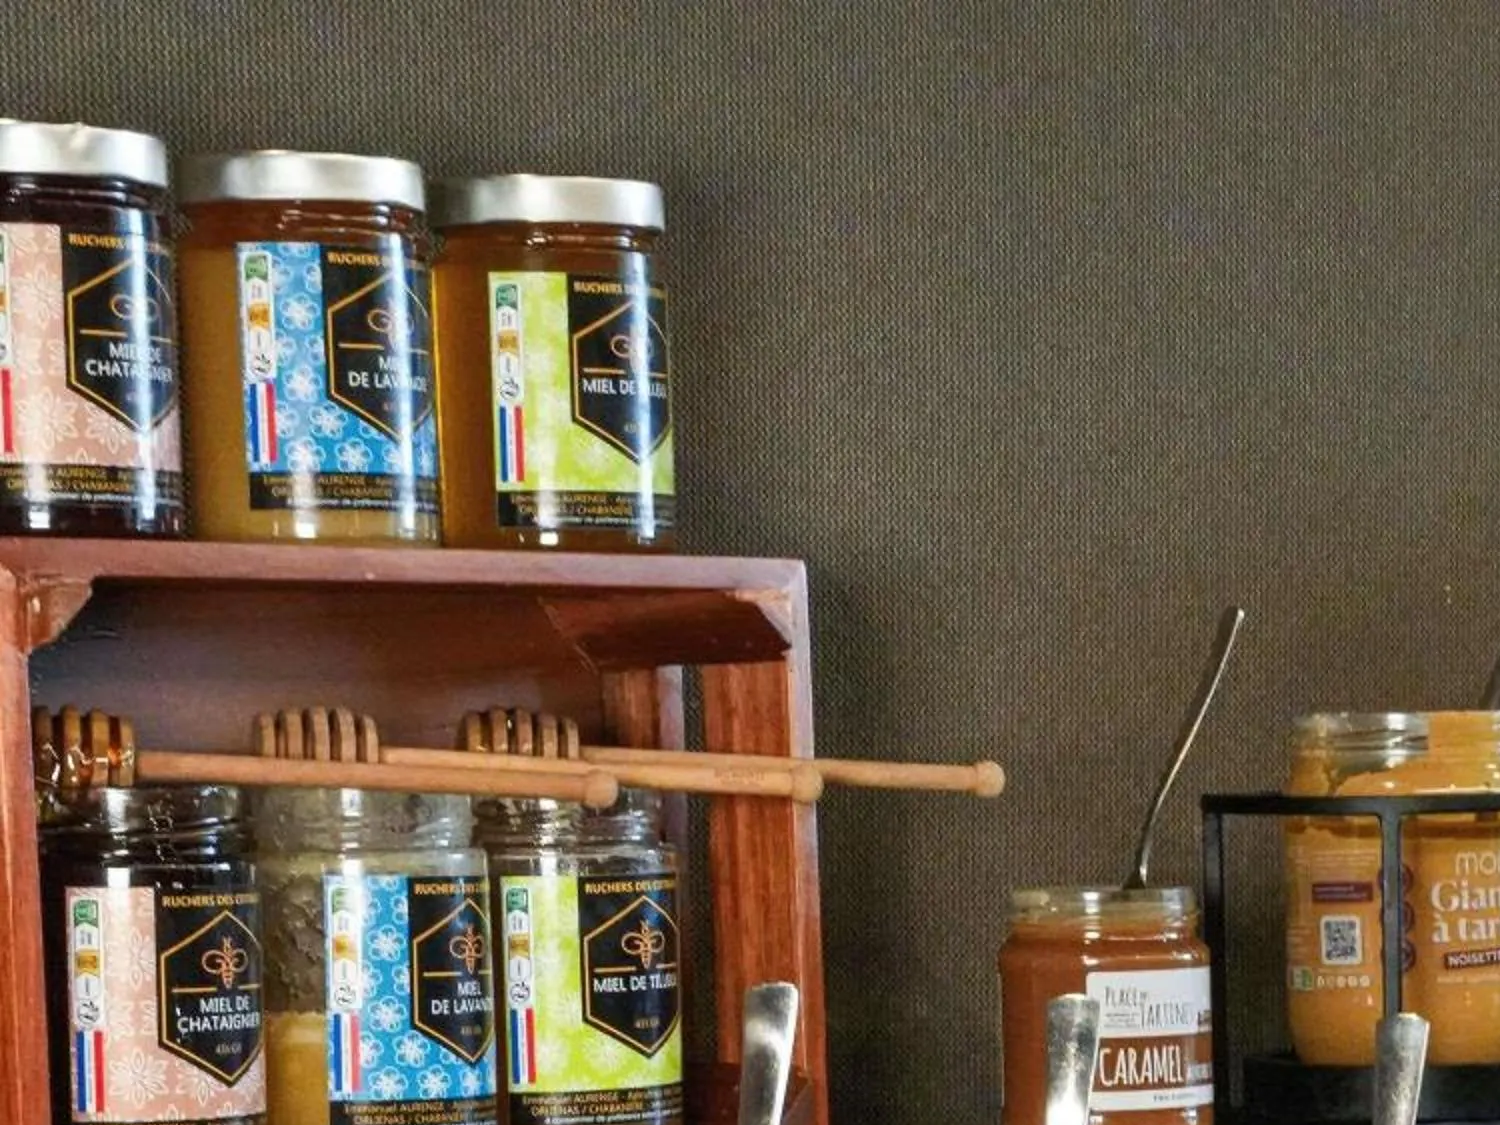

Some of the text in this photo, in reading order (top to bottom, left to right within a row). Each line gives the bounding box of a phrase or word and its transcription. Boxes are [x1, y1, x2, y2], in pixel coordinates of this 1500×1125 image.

[349, 371, 370, 388] DE
[583, 378, 617, 395] MIEL
[620, 380, 636, 395] DE
[593, 977, 627, 992] MIEL
[630, 976, 647, 991] DE
[200, 996, 250, 1014] MIEL DE
[431, 999, 450, 1015] DE
[1100, 1044, 1185, 1087] CARAMEL
